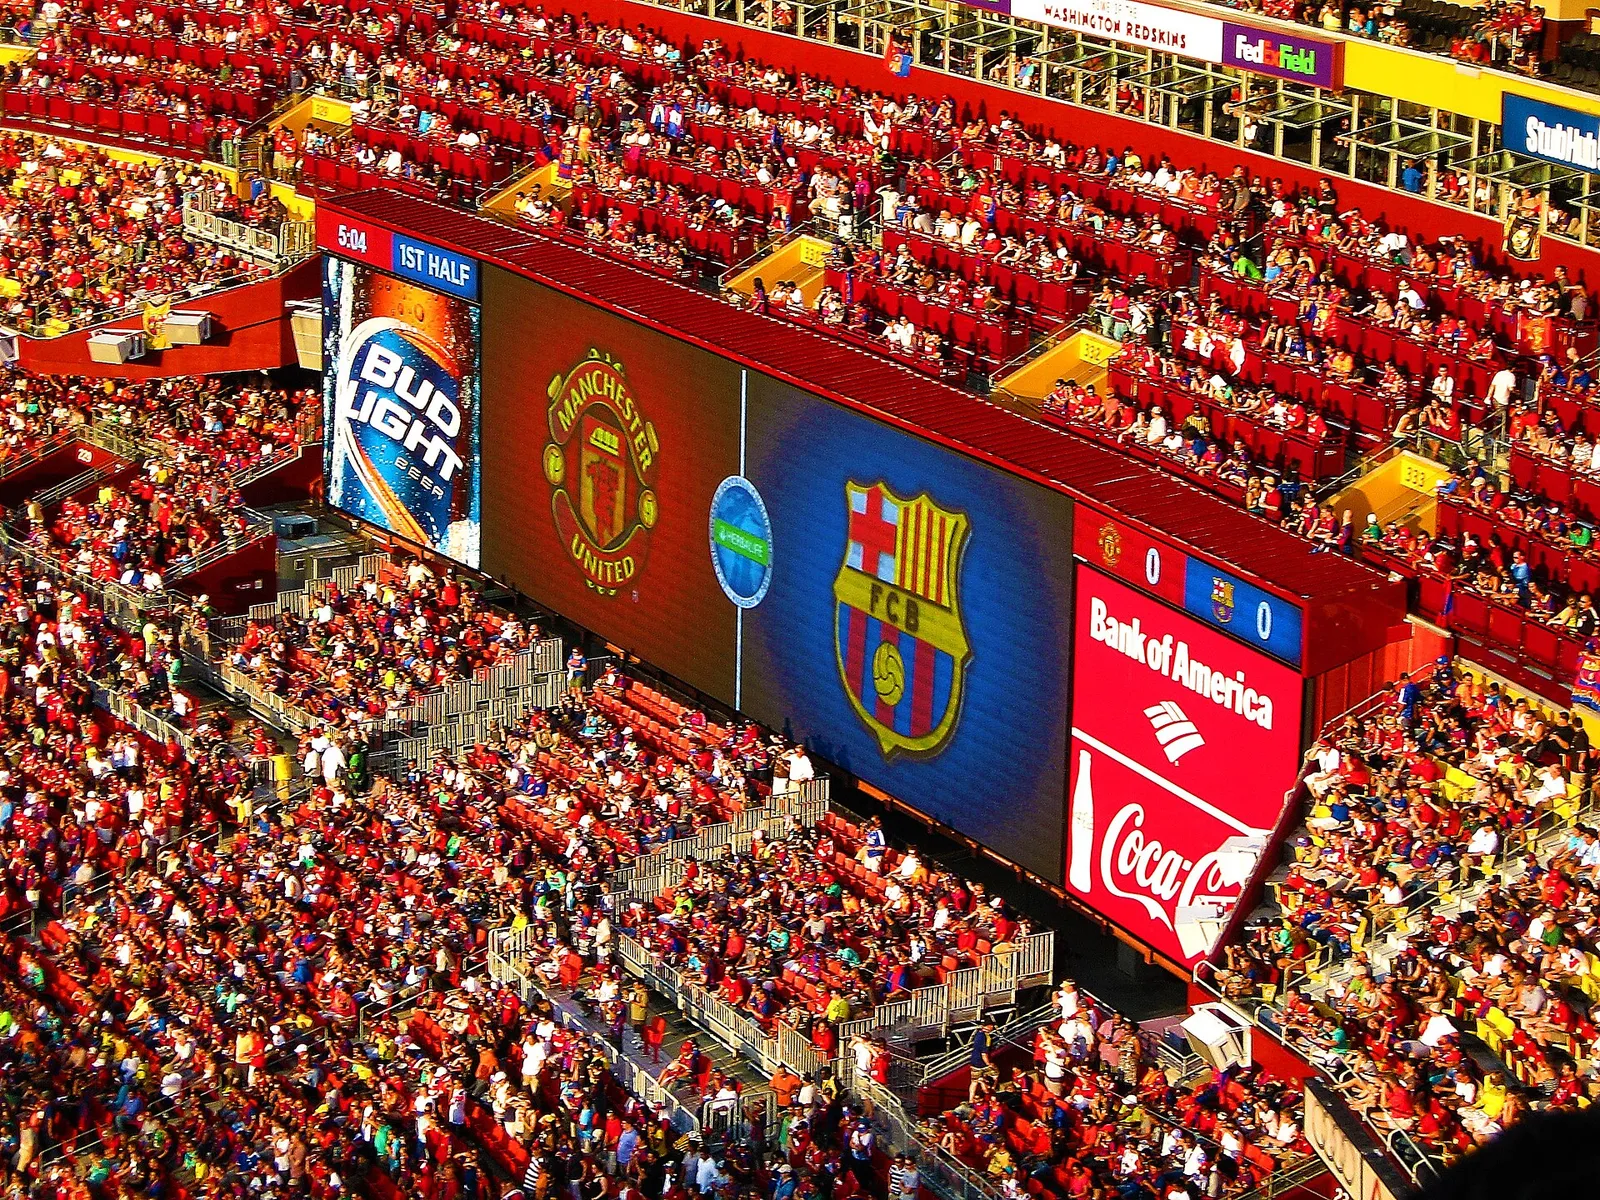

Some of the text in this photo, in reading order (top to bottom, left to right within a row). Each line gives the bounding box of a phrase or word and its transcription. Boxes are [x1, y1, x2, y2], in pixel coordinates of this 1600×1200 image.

[1044, 4, 1186, 49] WASHINGTON REDSKINS
[1235, 34, 1316, 75] FedExField
[1526, 115, 1600, 171] StubHub
[338, 225, 367, 253] 5:04
[400, 244, 471, 287] 1ST HALF
[360, 343, 462, 438] BUD
[346, 379, 464, 482] LIGHT
[558, 370, 652, 472] MANCHESTER
[394, 456, 444, 500] BEER
[572, 533, 635, 583] UNITED
[1145, 547, 1161, 586] 0
[869, 582, 919, 632] FCB
[1256, 601, 1272, 640] 0
[1090, 597, 1273, 730] Bank of America
[1100, 803, 1244, 931] Coca-Co
